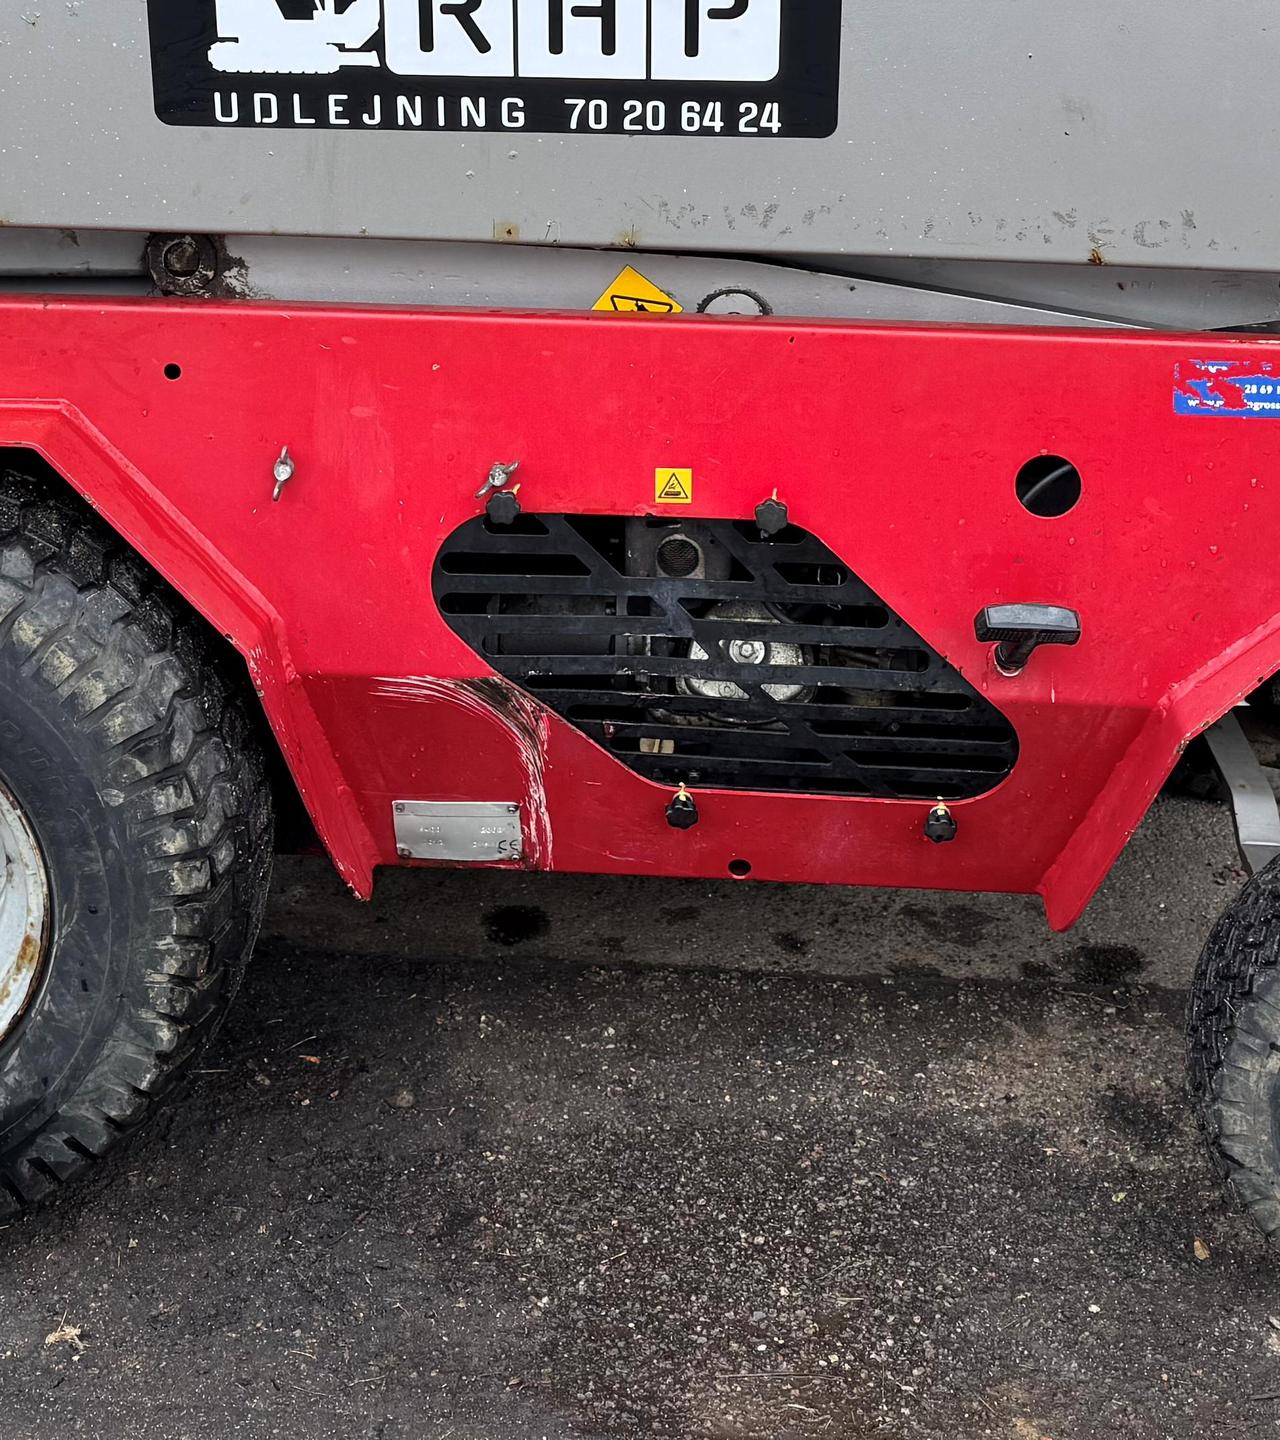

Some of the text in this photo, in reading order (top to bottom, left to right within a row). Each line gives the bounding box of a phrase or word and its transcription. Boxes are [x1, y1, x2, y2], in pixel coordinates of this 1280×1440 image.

[213, 91, 782, 134] UDLEJNING 70 20 64 24
[1244, 384, 1258, 394] 28
[1259, 384, 1274, 395] 69
